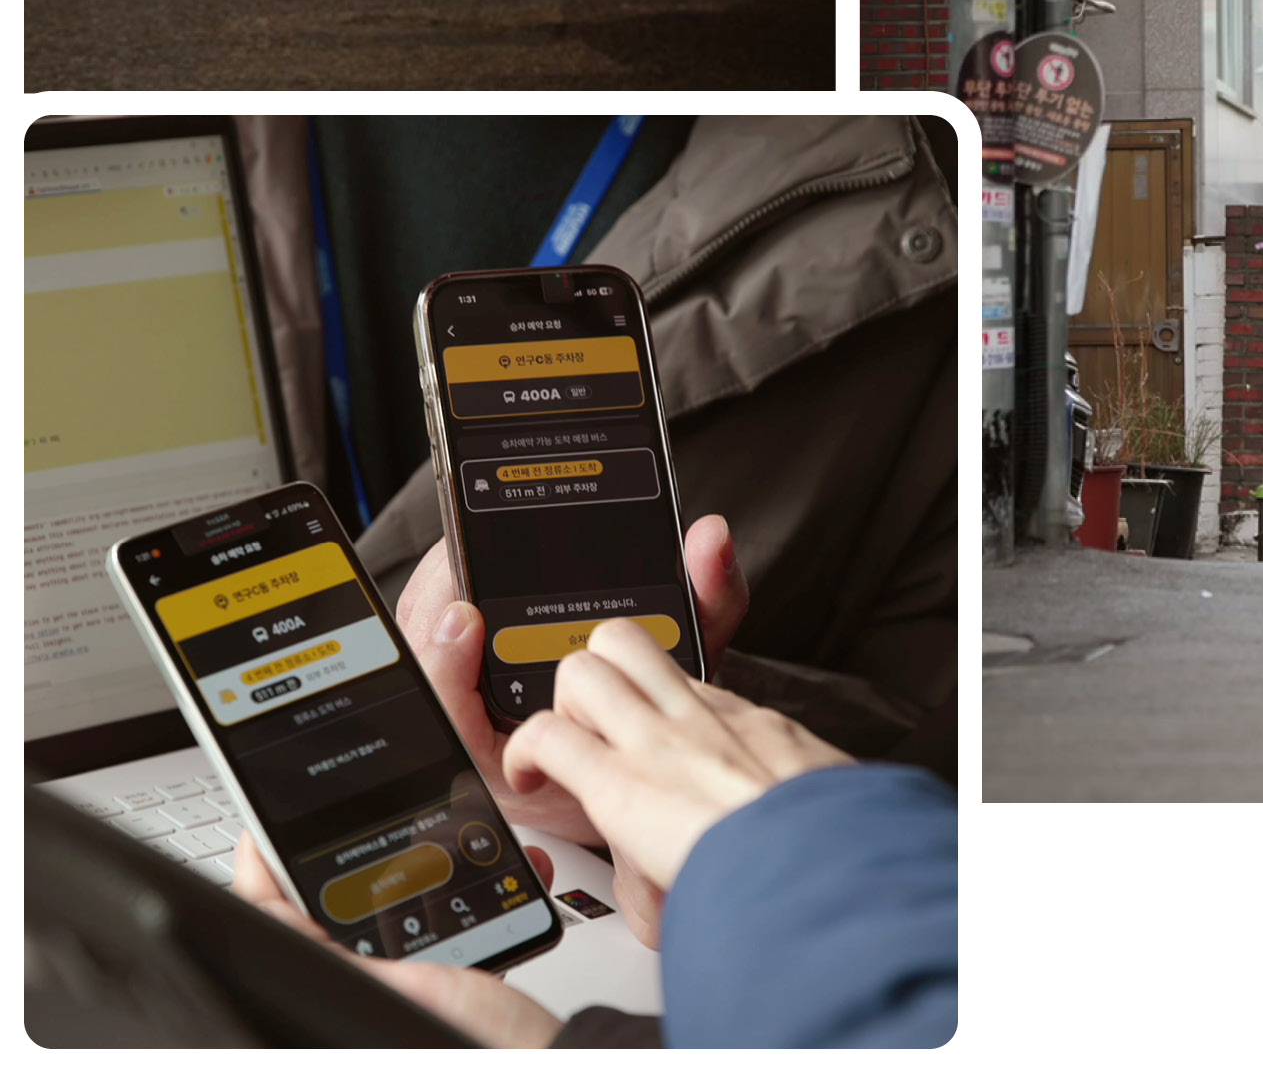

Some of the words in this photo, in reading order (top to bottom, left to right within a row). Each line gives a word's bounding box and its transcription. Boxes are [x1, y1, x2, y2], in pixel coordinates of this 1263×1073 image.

[457, 294, 478, 304] 1:31
[515, 353, 554, 367] 연구C동
[555, 351, 585, 364] 주차장
[520, 387, 562, 402] 400A
[591, 432, 608, 442] 버스
[502, 469, 509, 478] 4
[505, 487, 522, 498] 511
[524, 488, 535, 497] m
[536, 486, 546, 496] 전
[573, 482, 598, 493] 주차장
[271, 614, 307, 636] 400A
[568, 634, 590, 646] 승차
